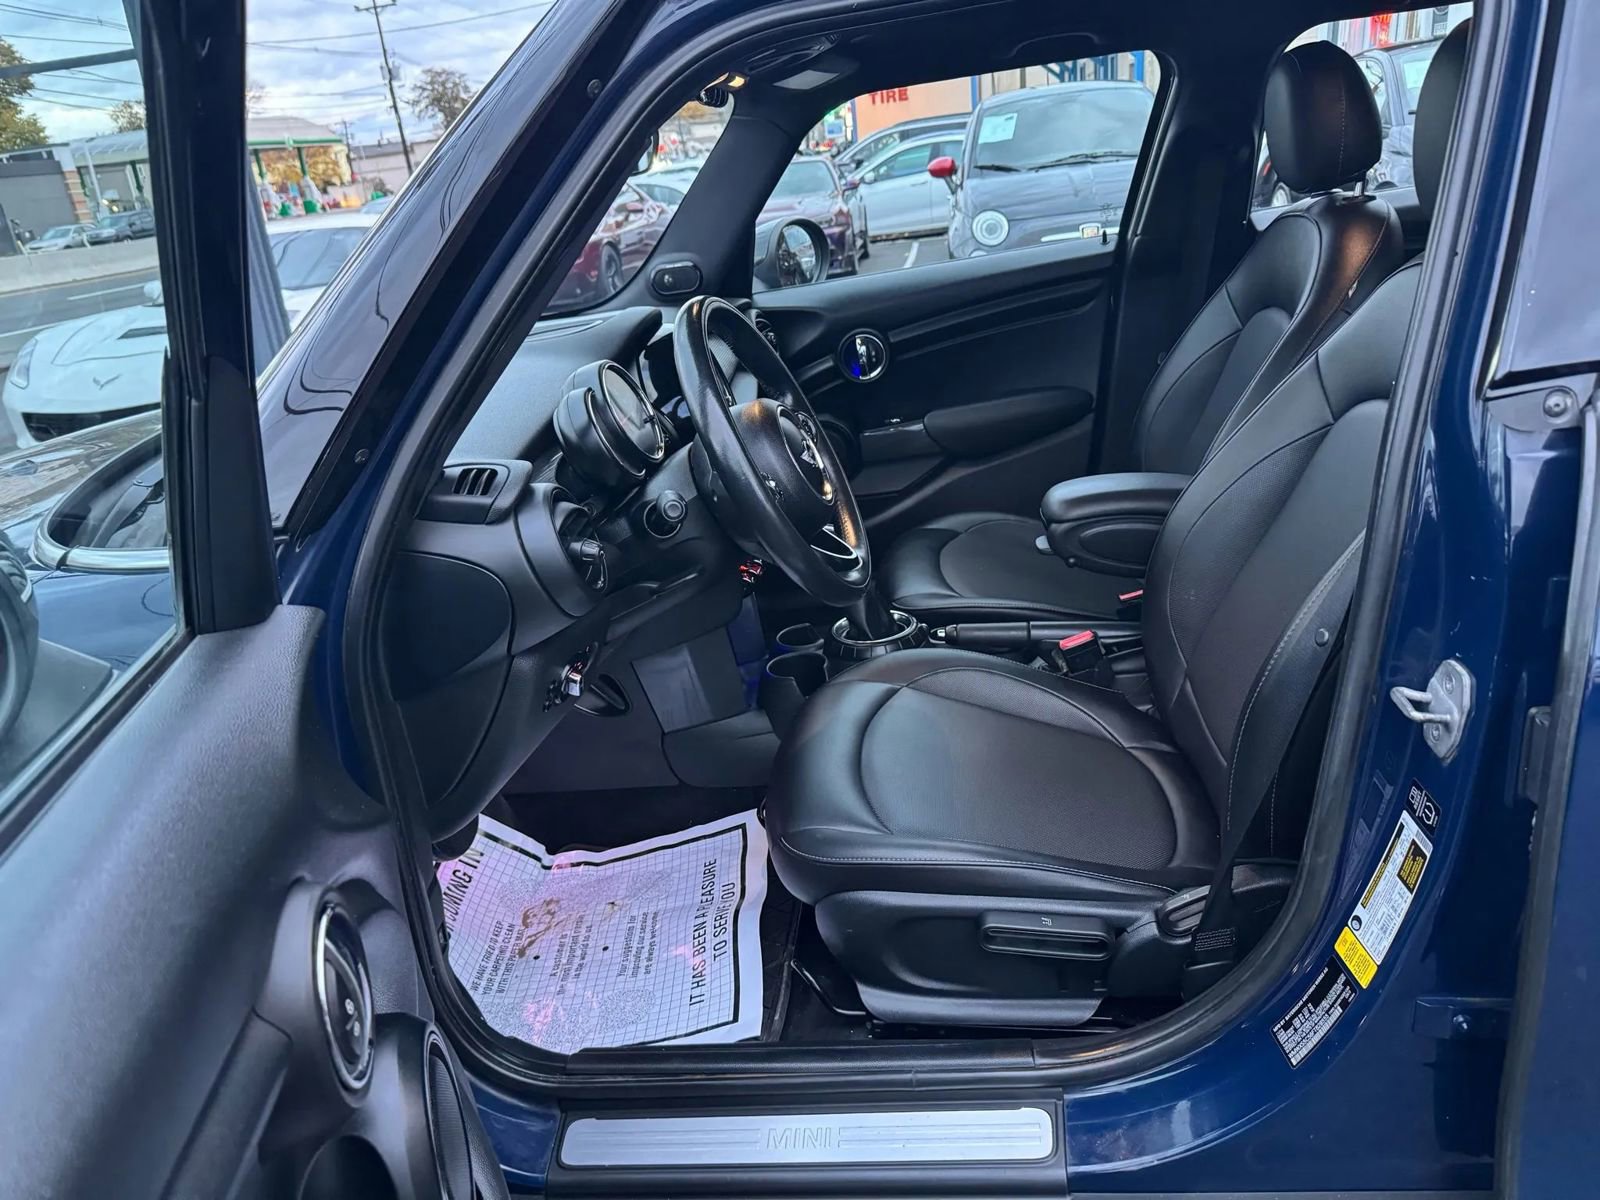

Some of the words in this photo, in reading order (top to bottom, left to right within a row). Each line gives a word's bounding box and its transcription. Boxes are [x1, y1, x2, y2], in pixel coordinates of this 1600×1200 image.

[870, 88, 909, 105] TIRE
[697, 859, 717, 911] PLEASURE
[720, 882, 736, 902] YOU
[627, 915, 636, 923] for
[695, 911, 708, 919] A
[714, 904, 731, 936] SERVE
[492, 920, 505, 938] KEEP
[693, 921, 706, 957] BEEN
[481, 945, 496, 964] TRIED
[565, 935, 580, 965] important
[579, 944, 588, 961] world
[622, 926, 635, 962] suggestions
[645, 941, 656, 962] always
[714, 940, 727, 961] TO
[482, 978, 496, 996] YOUR
[489, 944, 509, 977] CARPETING
[502, 923, 516, 944] CLEAN
[552, 940, 565, 970] customer
[628, 946, 644, 978] improving
[474, 964, 488, 980] HAVE
[496, 978, 509, 994] WITH
[503, 962, 515, 976] THIS
[616, 964, 628, 976] Your
[644, 964, 652, 974] are
[692, 960, 706, 989] HAS
[470, 981, 481, 991] WE
[689, 993, 705, 1006] IT
[766, 1127, 832, 1149] MINI
